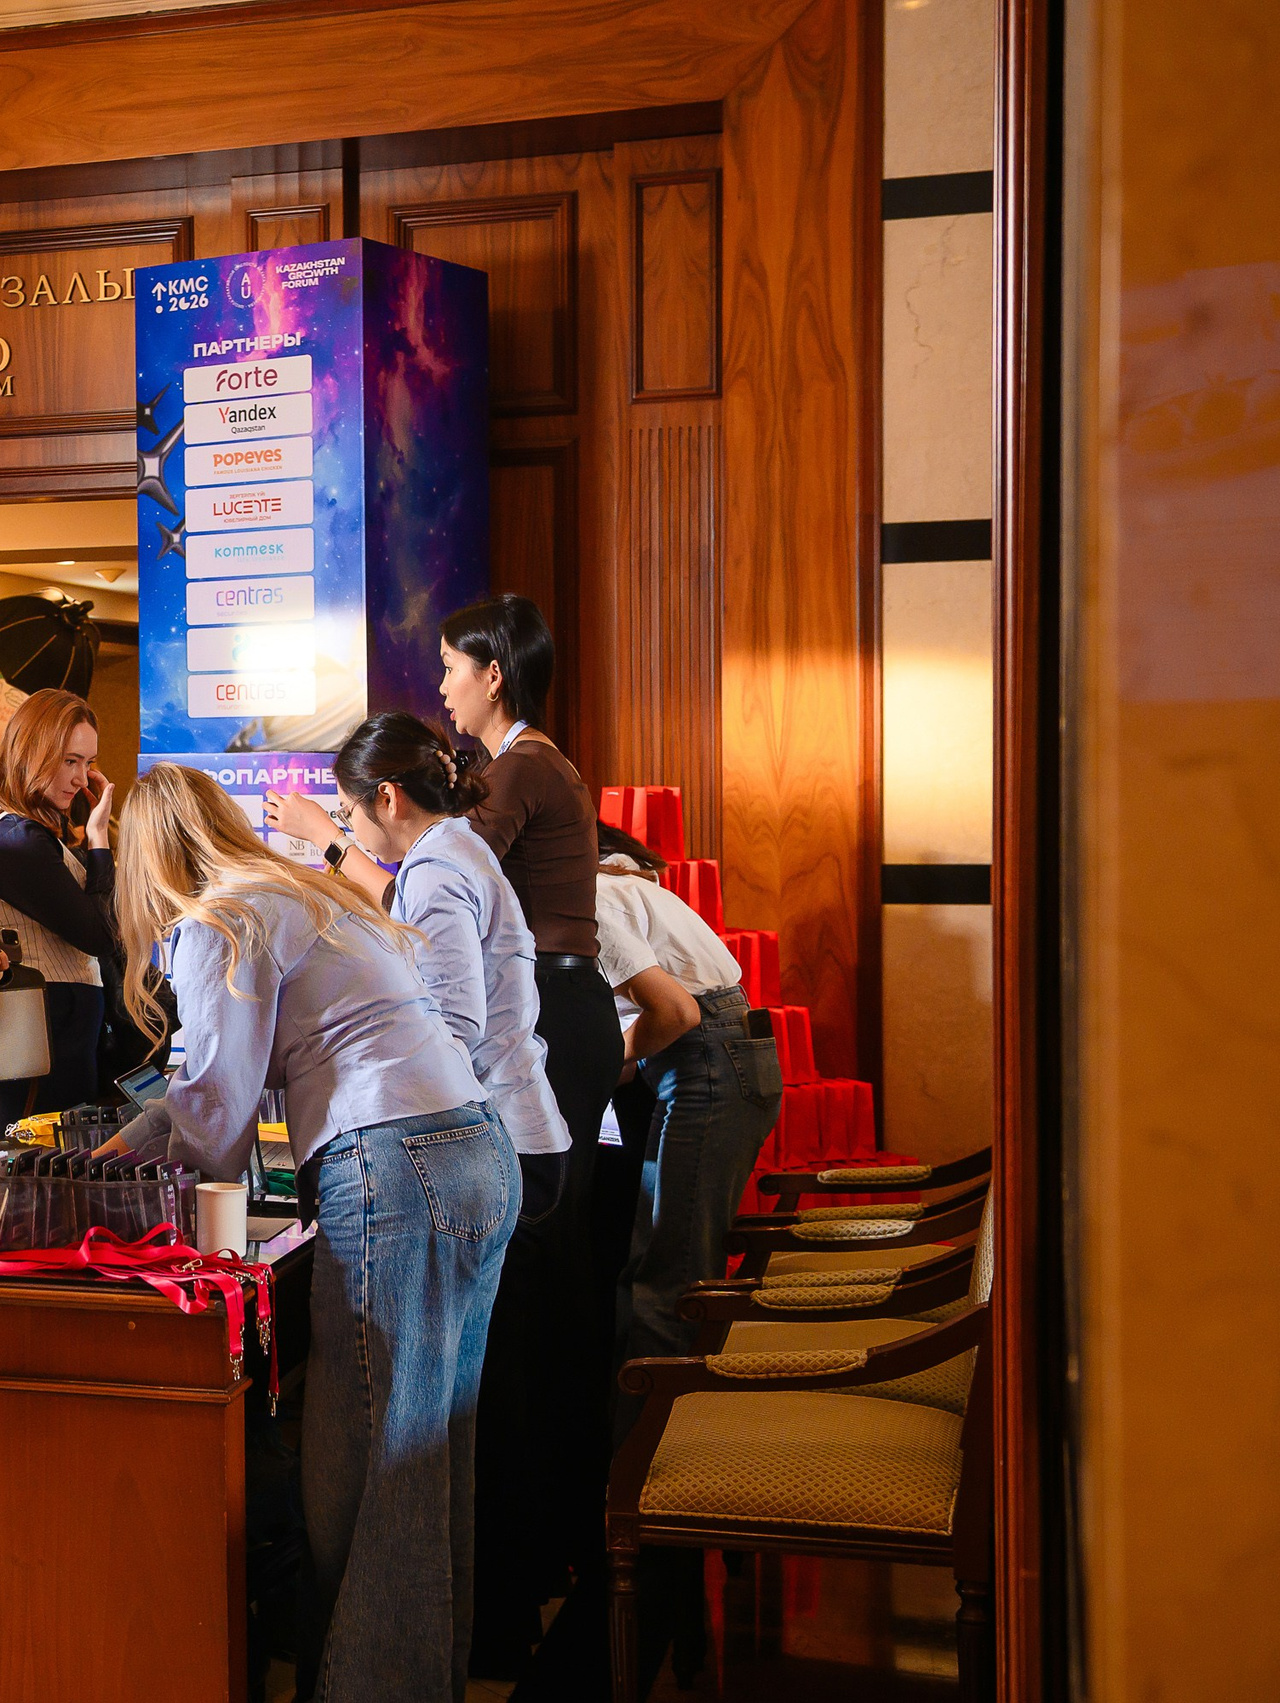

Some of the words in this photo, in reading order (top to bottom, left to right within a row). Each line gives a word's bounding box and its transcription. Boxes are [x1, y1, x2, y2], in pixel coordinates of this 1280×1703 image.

[275, 257, 345, 273] KAZAKHSTAN
[288, 267, 338, 280] GROWTH
[0, 267, 135, 308] ЗАЛЫ
[169, 275, 209, 295] KMC
[281, 277, 319, 290] FORUM
[169, 293, 209, 312] 2026
[193, 331, 302, 358] ПАРТНЕРЫ
[216, 366, 278, 392] Forte
[218, 403, 277, 424] Yandex
[216, 586, 283, 607] centras
